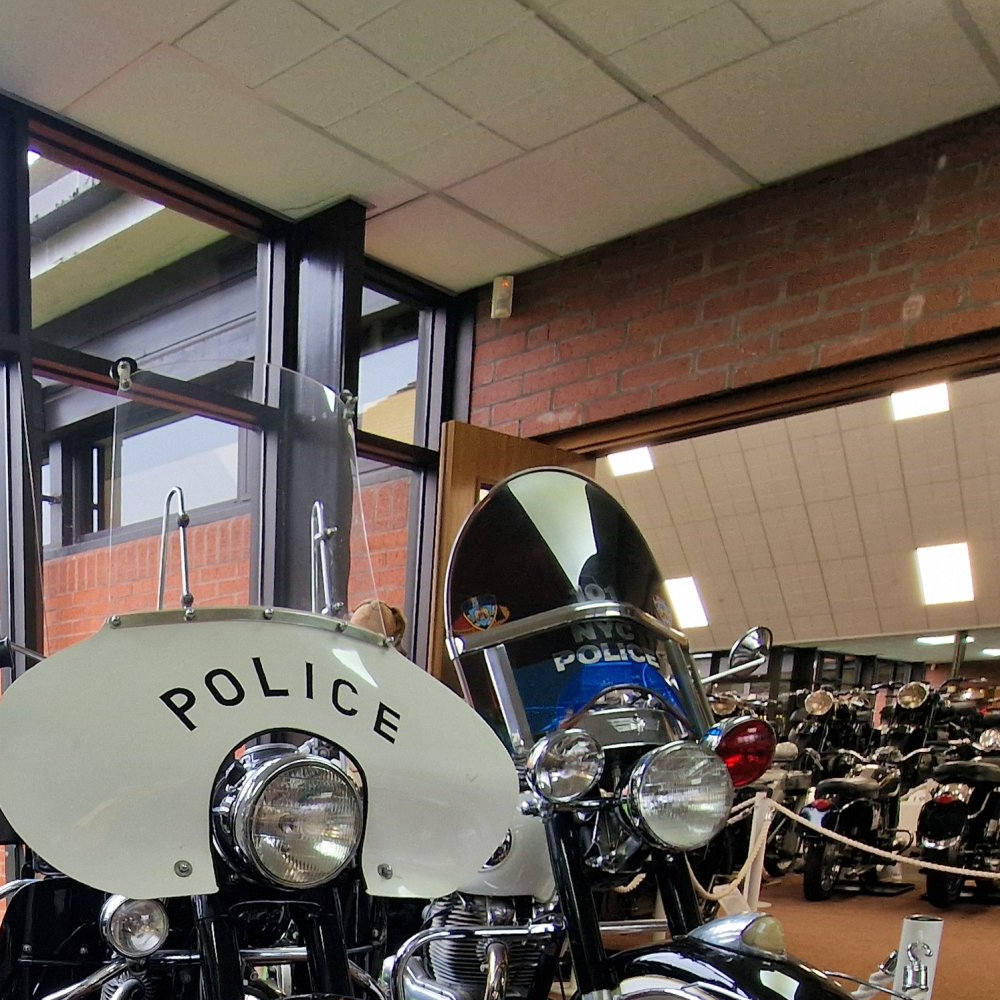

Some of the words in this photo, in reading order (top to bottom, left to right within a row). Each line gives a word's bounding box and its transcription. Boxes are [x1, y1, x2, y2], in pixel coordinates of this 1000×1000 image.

[571, 621, 635, 643] NYC
[552, 642, 660, 673] POLICE
[159, 656, 401, 744] POLICE
